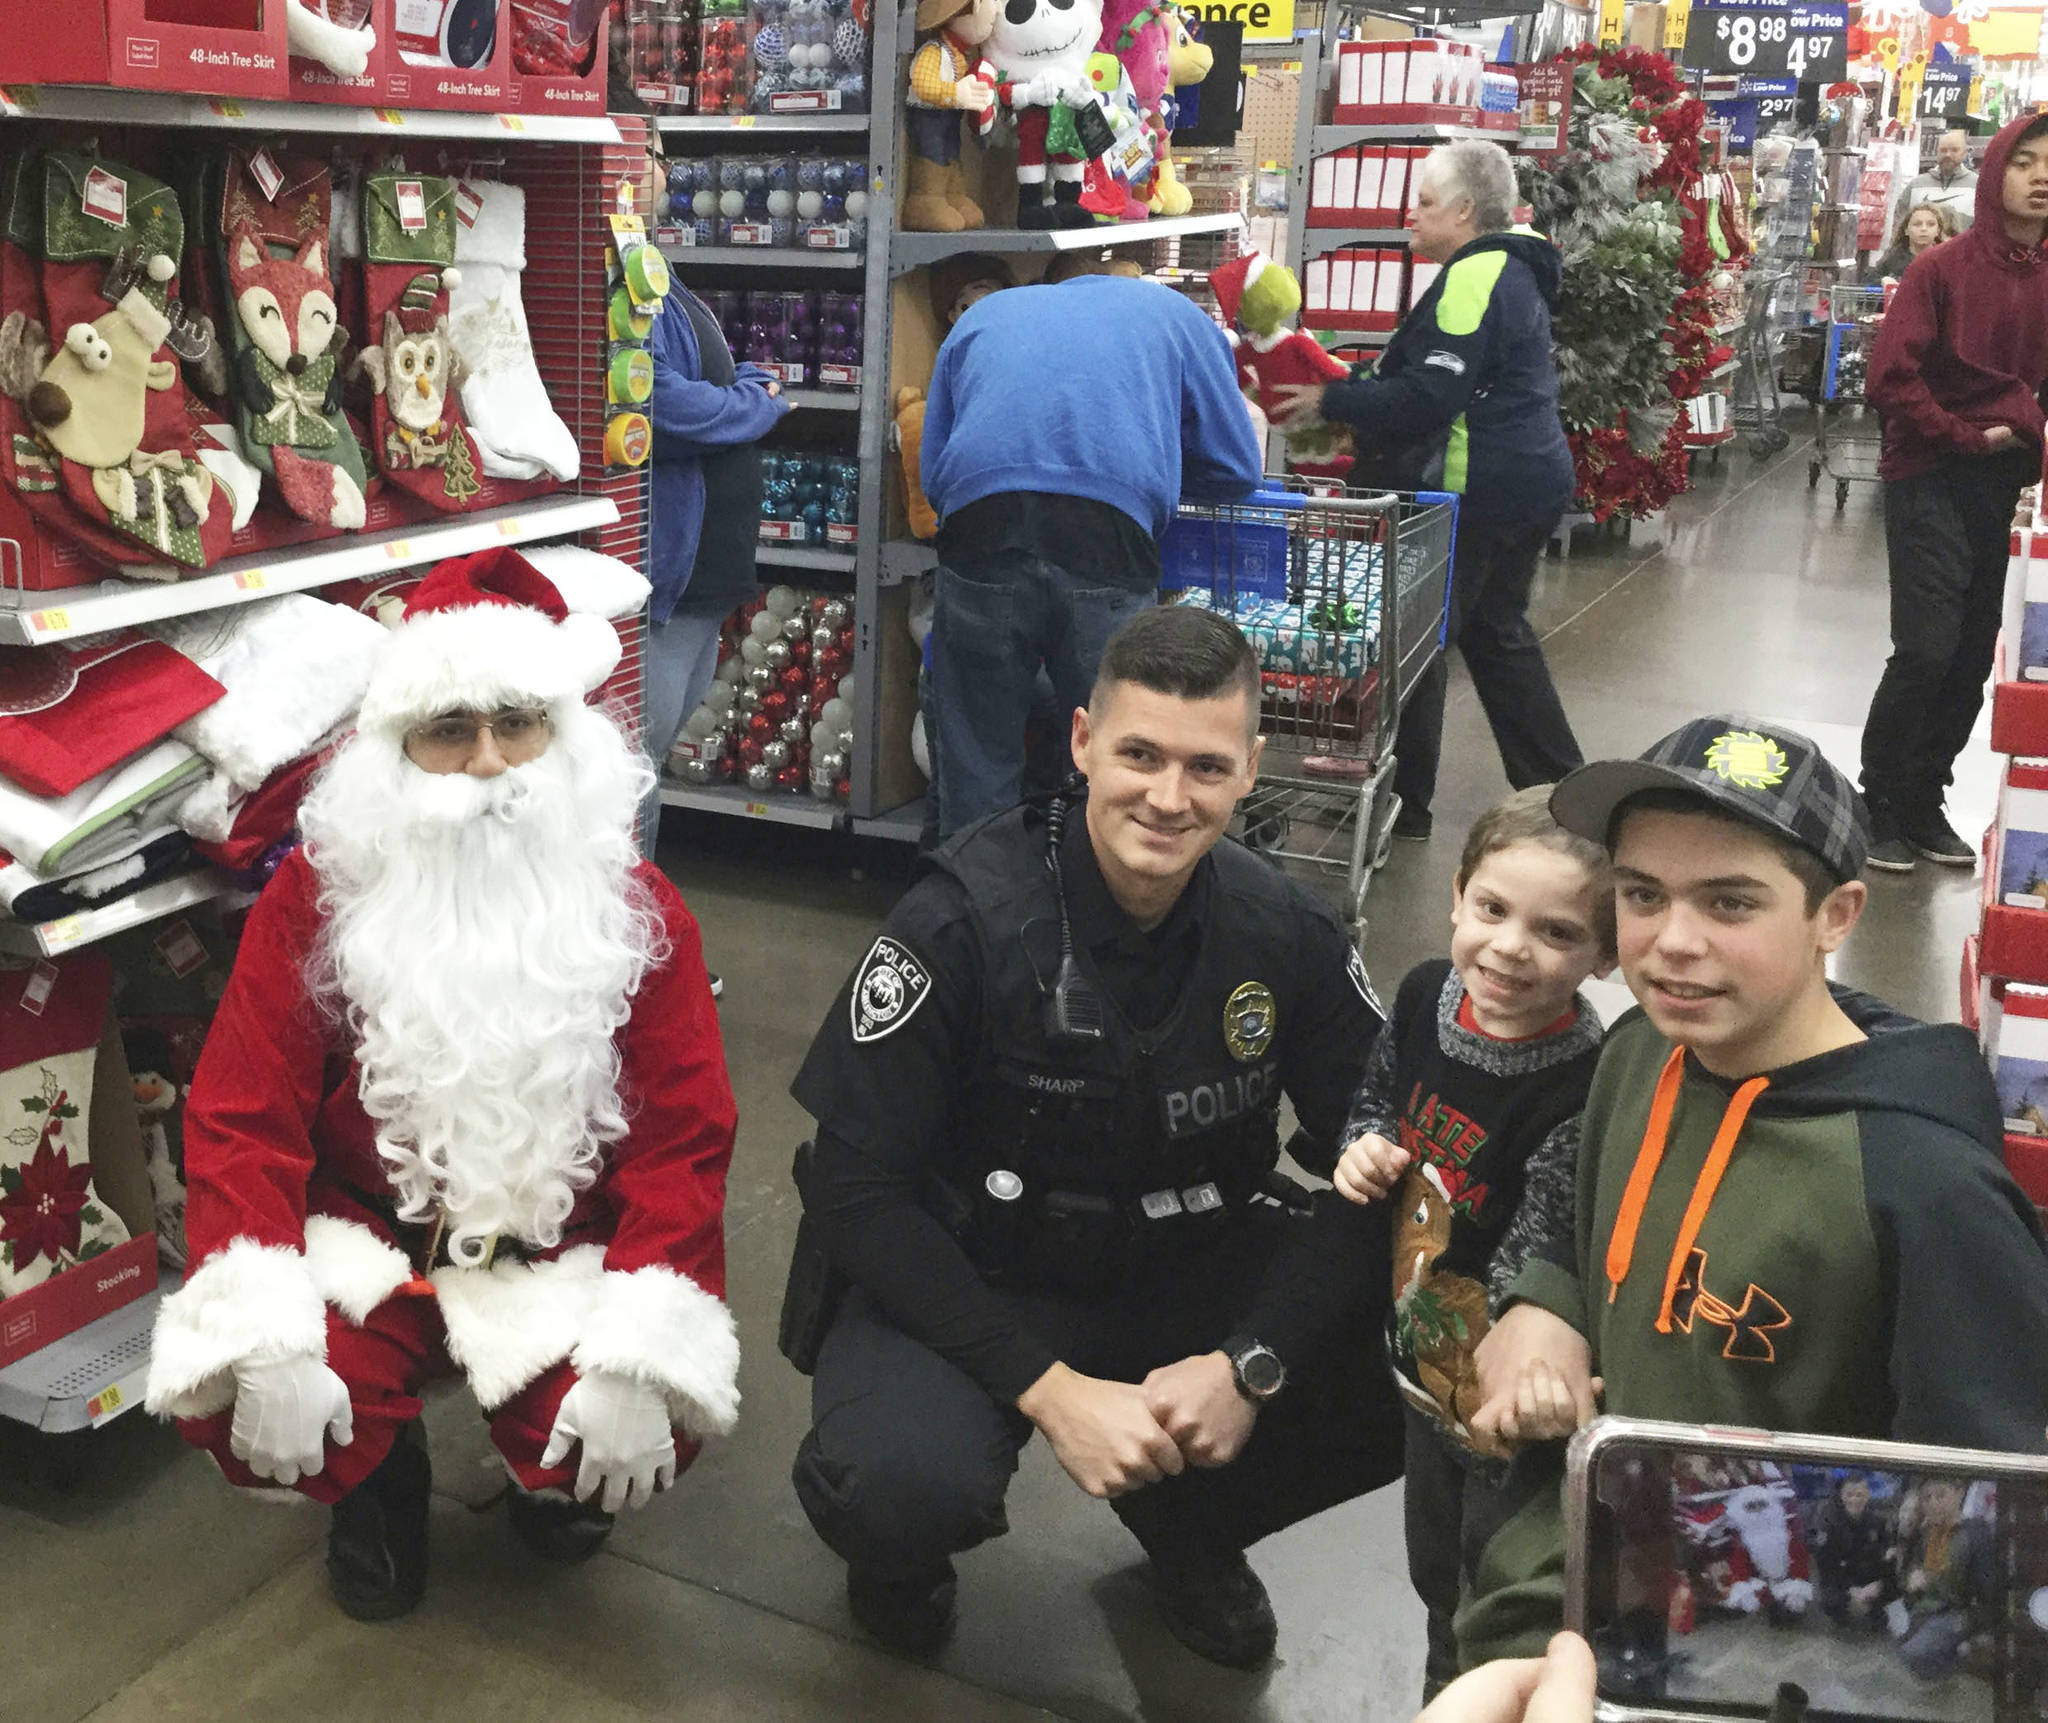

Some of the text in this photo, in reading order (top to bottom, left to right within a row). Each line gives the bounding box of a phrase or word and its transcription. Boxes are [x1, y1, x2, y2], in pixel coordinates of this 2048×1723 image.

[1605, 17, 1618, 32] H
[1811, 13, 1844, 27] Price
[190, 48, 275, 70] 48-Inch Tree Skirt
[355, 75, 375, 88] Skirt
[1941, 73, 1959, 82] Price
[437, 80, 501, 97] 48-Inch Tree Skirt
[544, 87, 600, 103] 48-Inch Tree Skirt
[876, 943, 926, 991] POLICE
[1028, 1074, 1085, 1093] SHARP
[1166, 1061, 1278, 1133] POLICE
[1407, 1081, 1488, 1166] I ATE
[96, 1264, 140, 1293] Stocking
